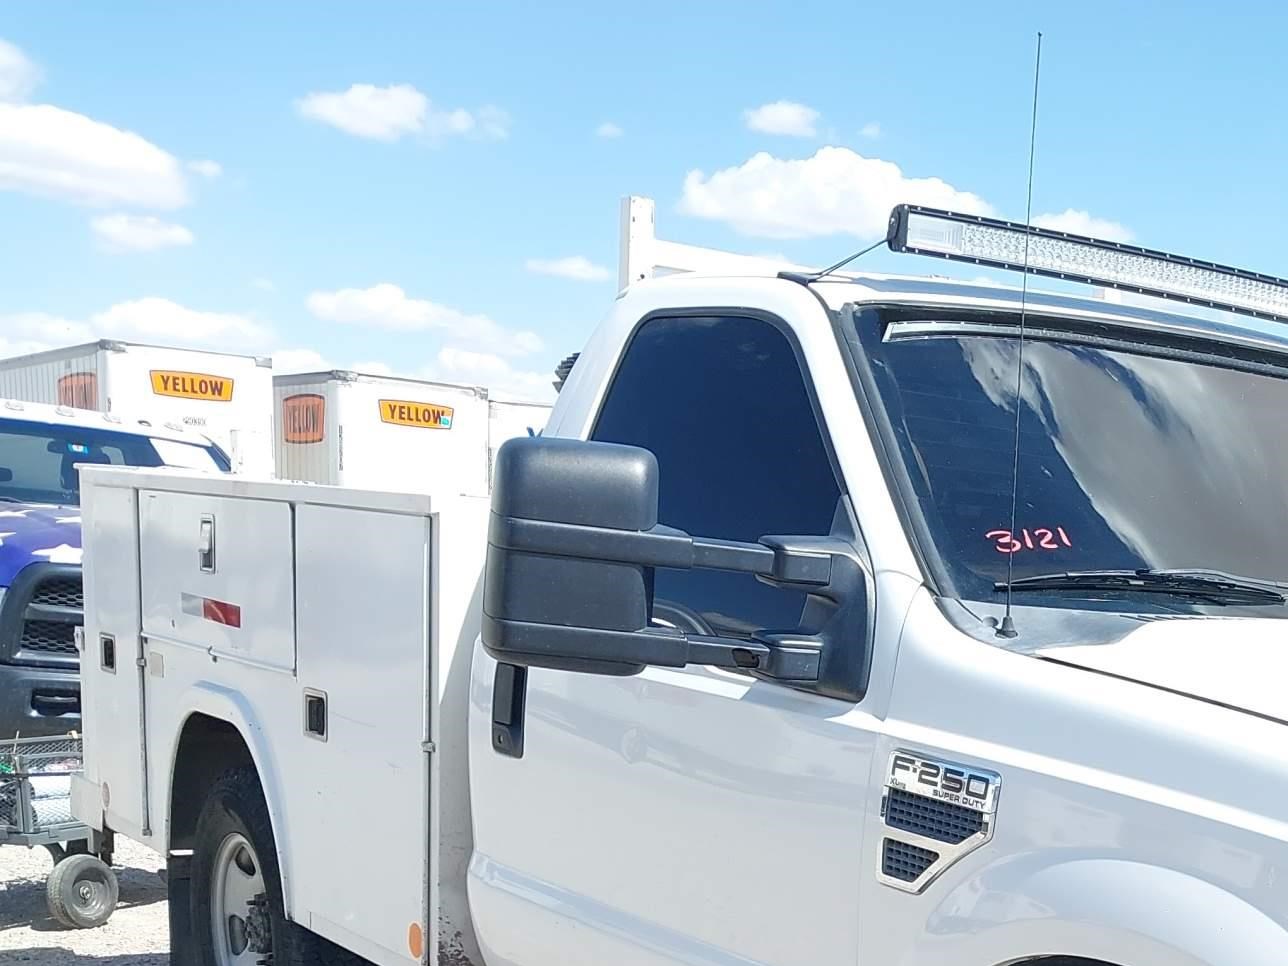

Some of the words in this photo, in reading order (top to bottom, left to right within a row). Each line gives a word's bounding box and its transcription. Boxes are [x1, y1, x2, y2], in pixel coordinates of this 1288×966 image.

[160, 374, 224, 397] YELLOW
[388, 403, 445, 425] YELLOW
[985, 527, 1072, 552] 3121
[891, 755, 989, 800] F-250
[932, 789, 960, 803] SUPER
[961, 797, 986, 809] DUTY
